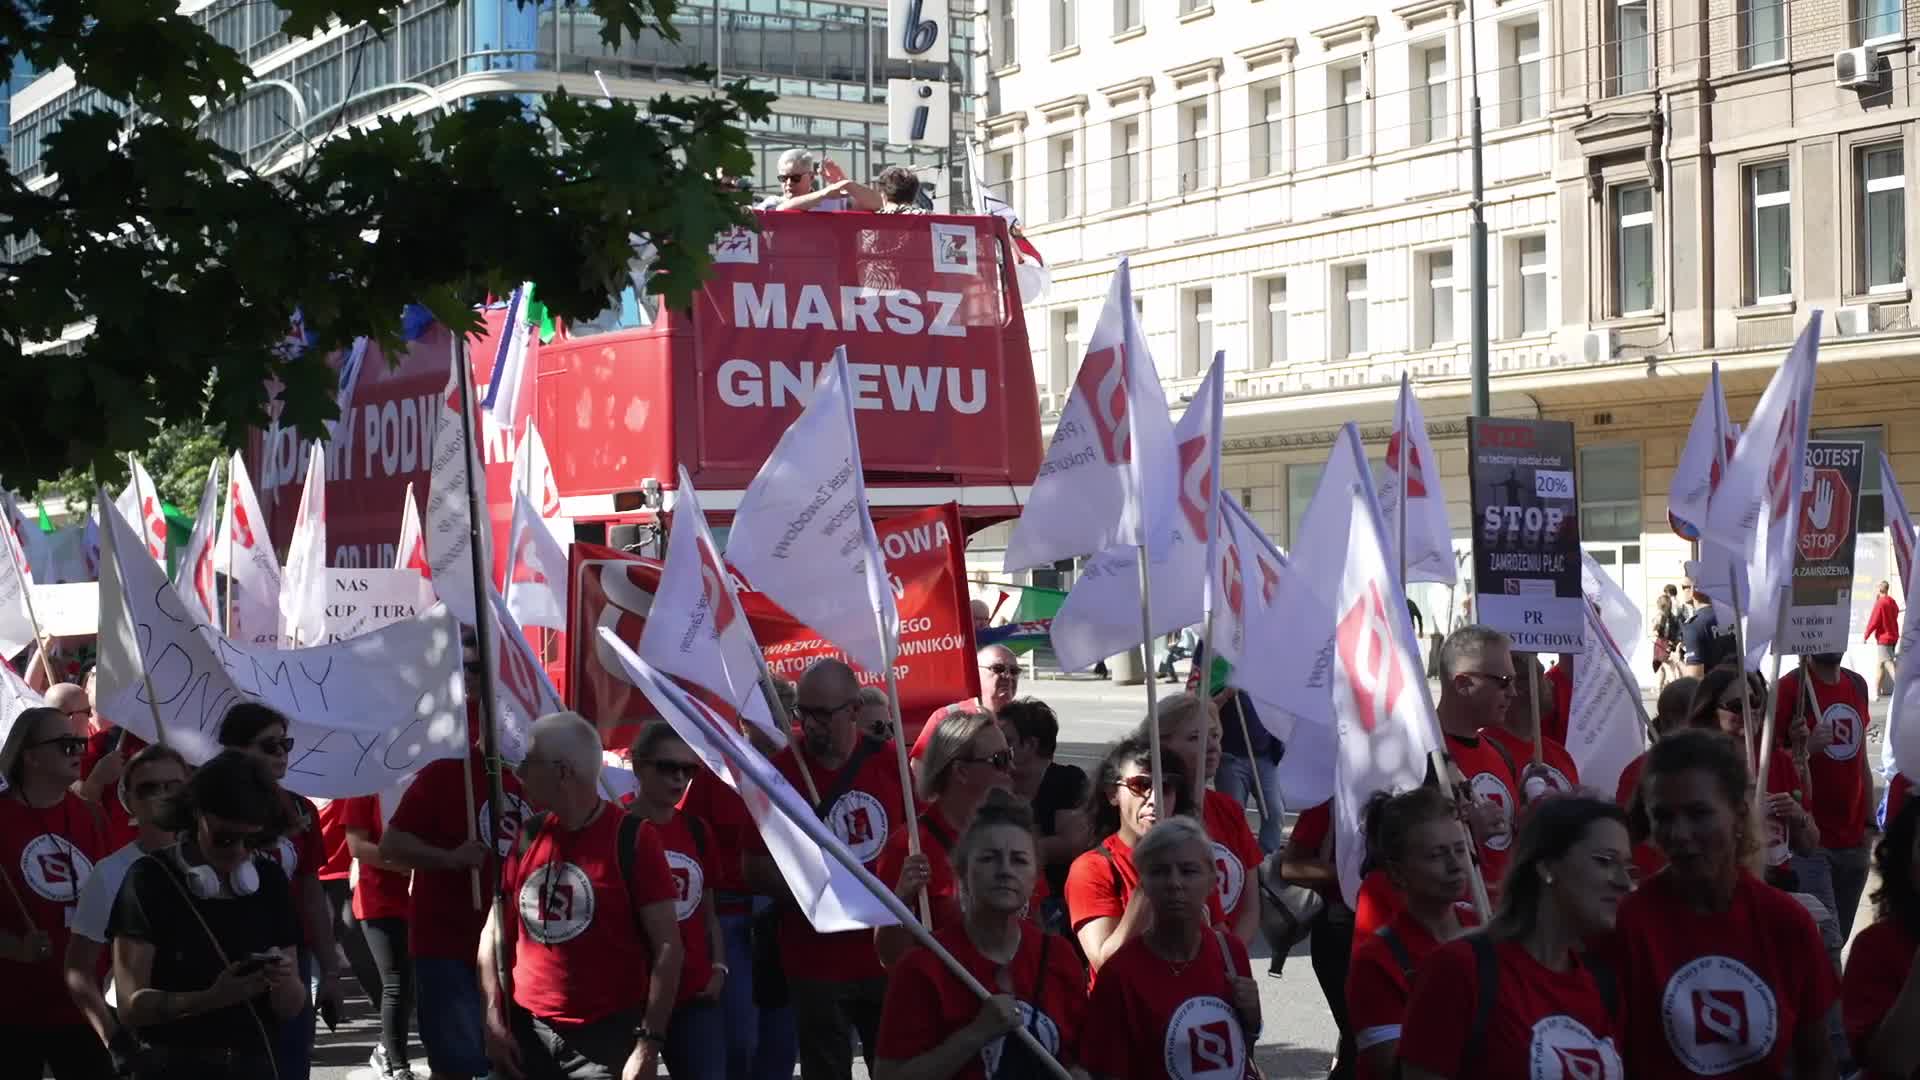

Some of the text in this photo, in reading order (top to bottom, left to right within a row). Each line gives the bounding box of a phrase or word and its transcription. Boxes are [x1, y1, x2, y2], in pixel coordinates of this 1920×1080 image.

[733, 282, 967, 337] MARSZ
[1806, 448, 1860, 466] ROTEST
[1537, 475, 1568, 493] 20%
[1485, 505, 1564, 531] STOP
[884, 520, 951, 560] OWA
[1803, 534, 1836, 549] STOP
[336, 578, 369, 592] NAS
[1524, 610, 1544, 624] PR
[1510, 631, 1583, 647] STOCHOWA
